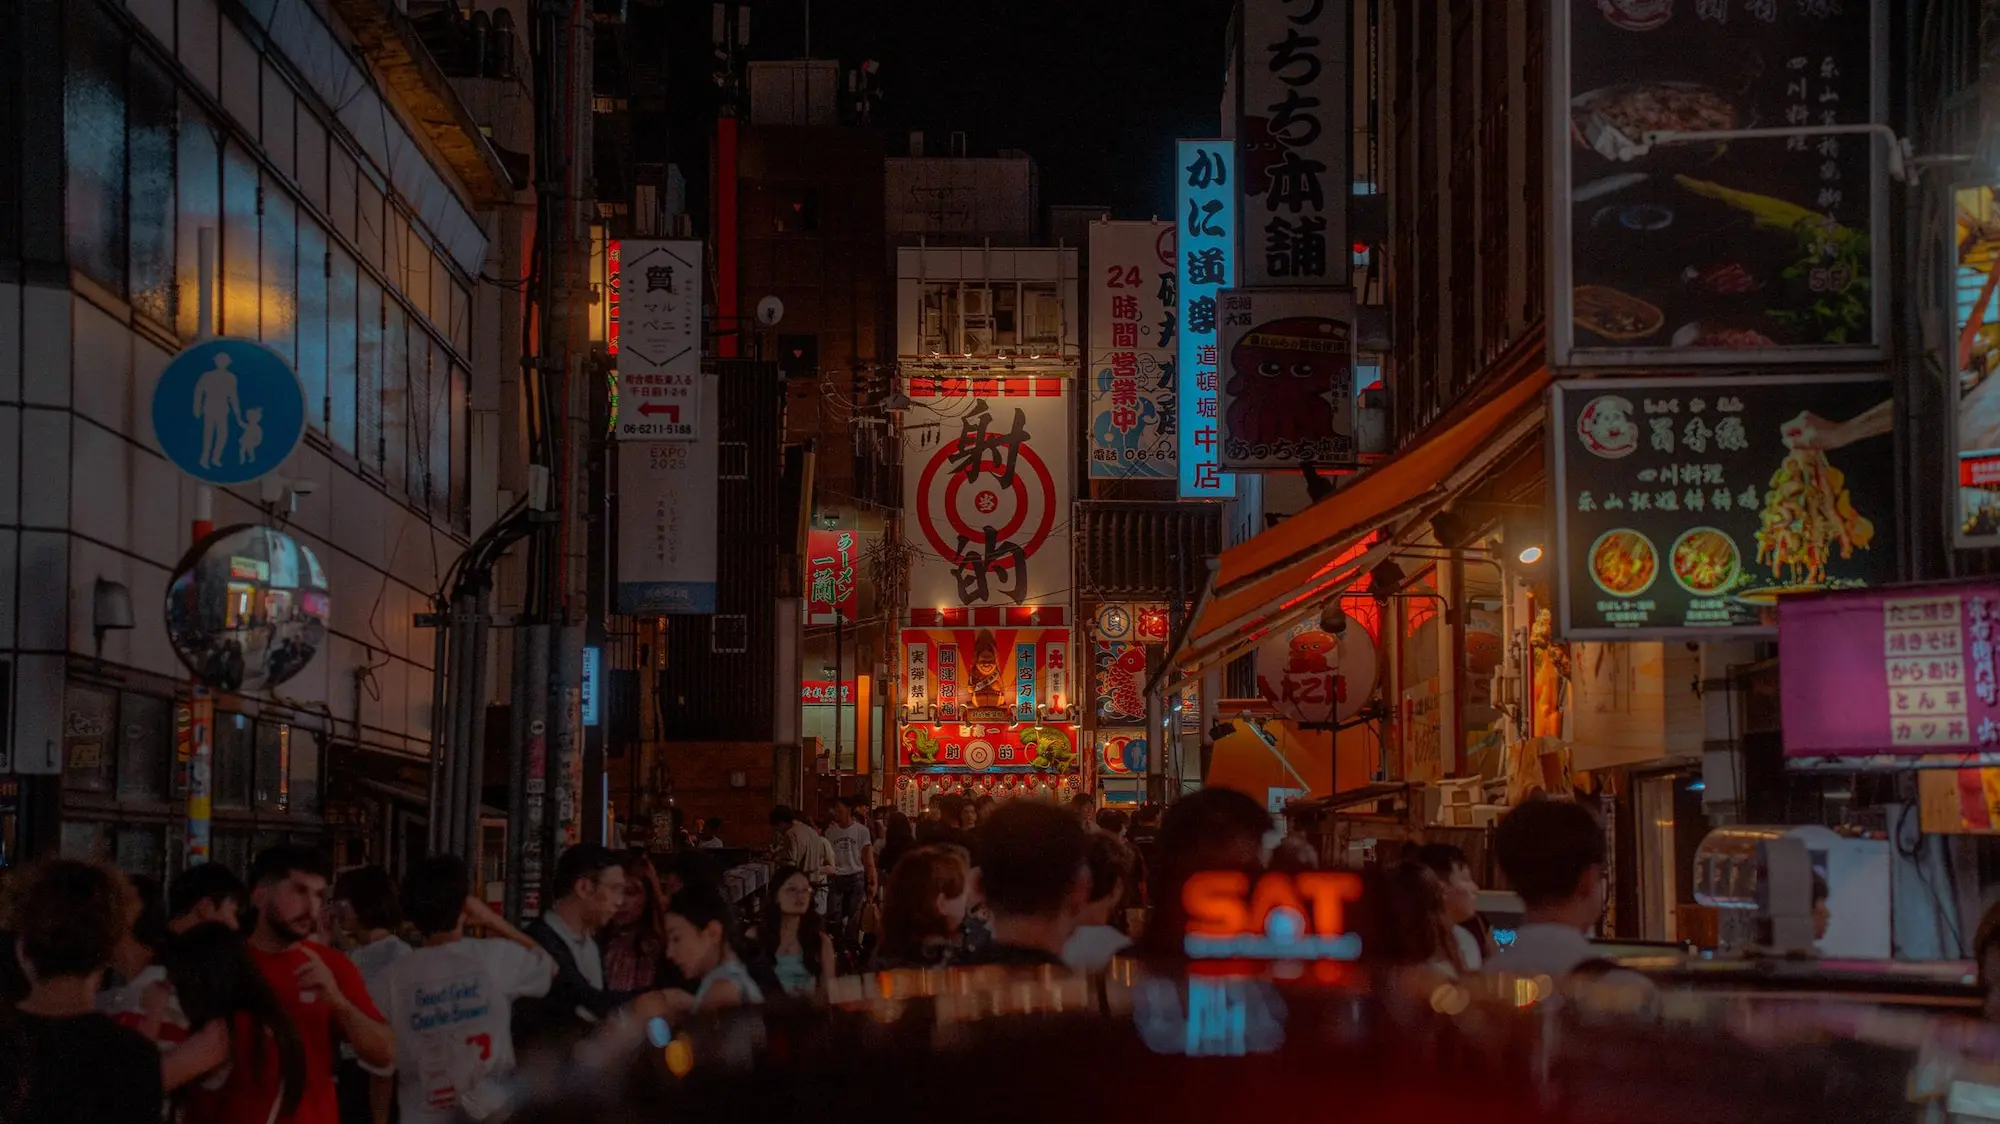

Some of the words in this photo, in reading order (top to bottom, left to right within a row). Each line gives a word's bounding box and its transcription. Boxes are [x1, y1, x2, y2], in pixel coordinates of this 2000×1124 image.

[645, 265, 674, 293] 質
[1194, 345, 1221, 489] 道頓堀中店
[650, 448, 687, 458] EXPO
[650, 459, 686, 469] 2025
[811, 557, 836, 605] 一蘭
[837, 533, 854, 602] ラーメン
